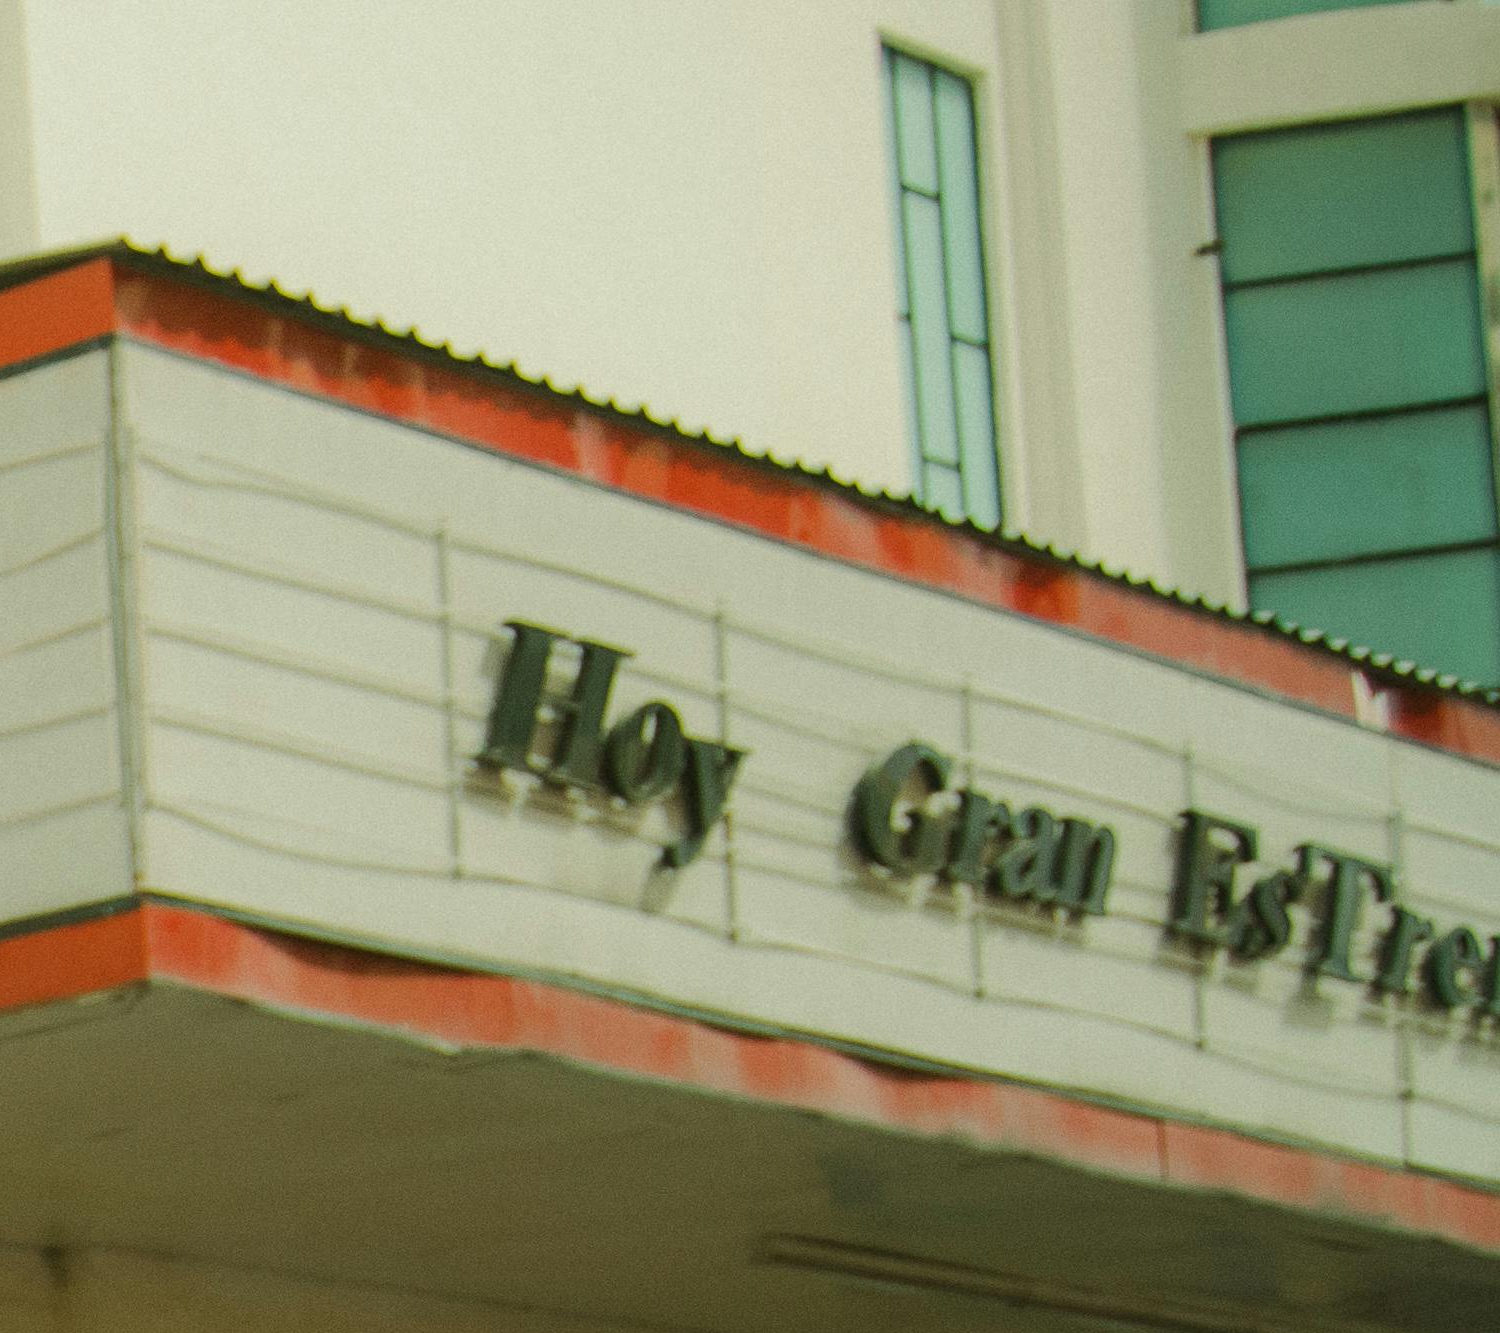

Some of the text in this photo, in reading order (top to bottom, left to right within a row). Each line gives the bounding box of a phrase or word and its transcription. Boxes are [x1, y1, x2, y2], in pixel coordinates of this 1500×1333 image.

[472, 620, 1500, 1022] Hoy Gran EsTre
